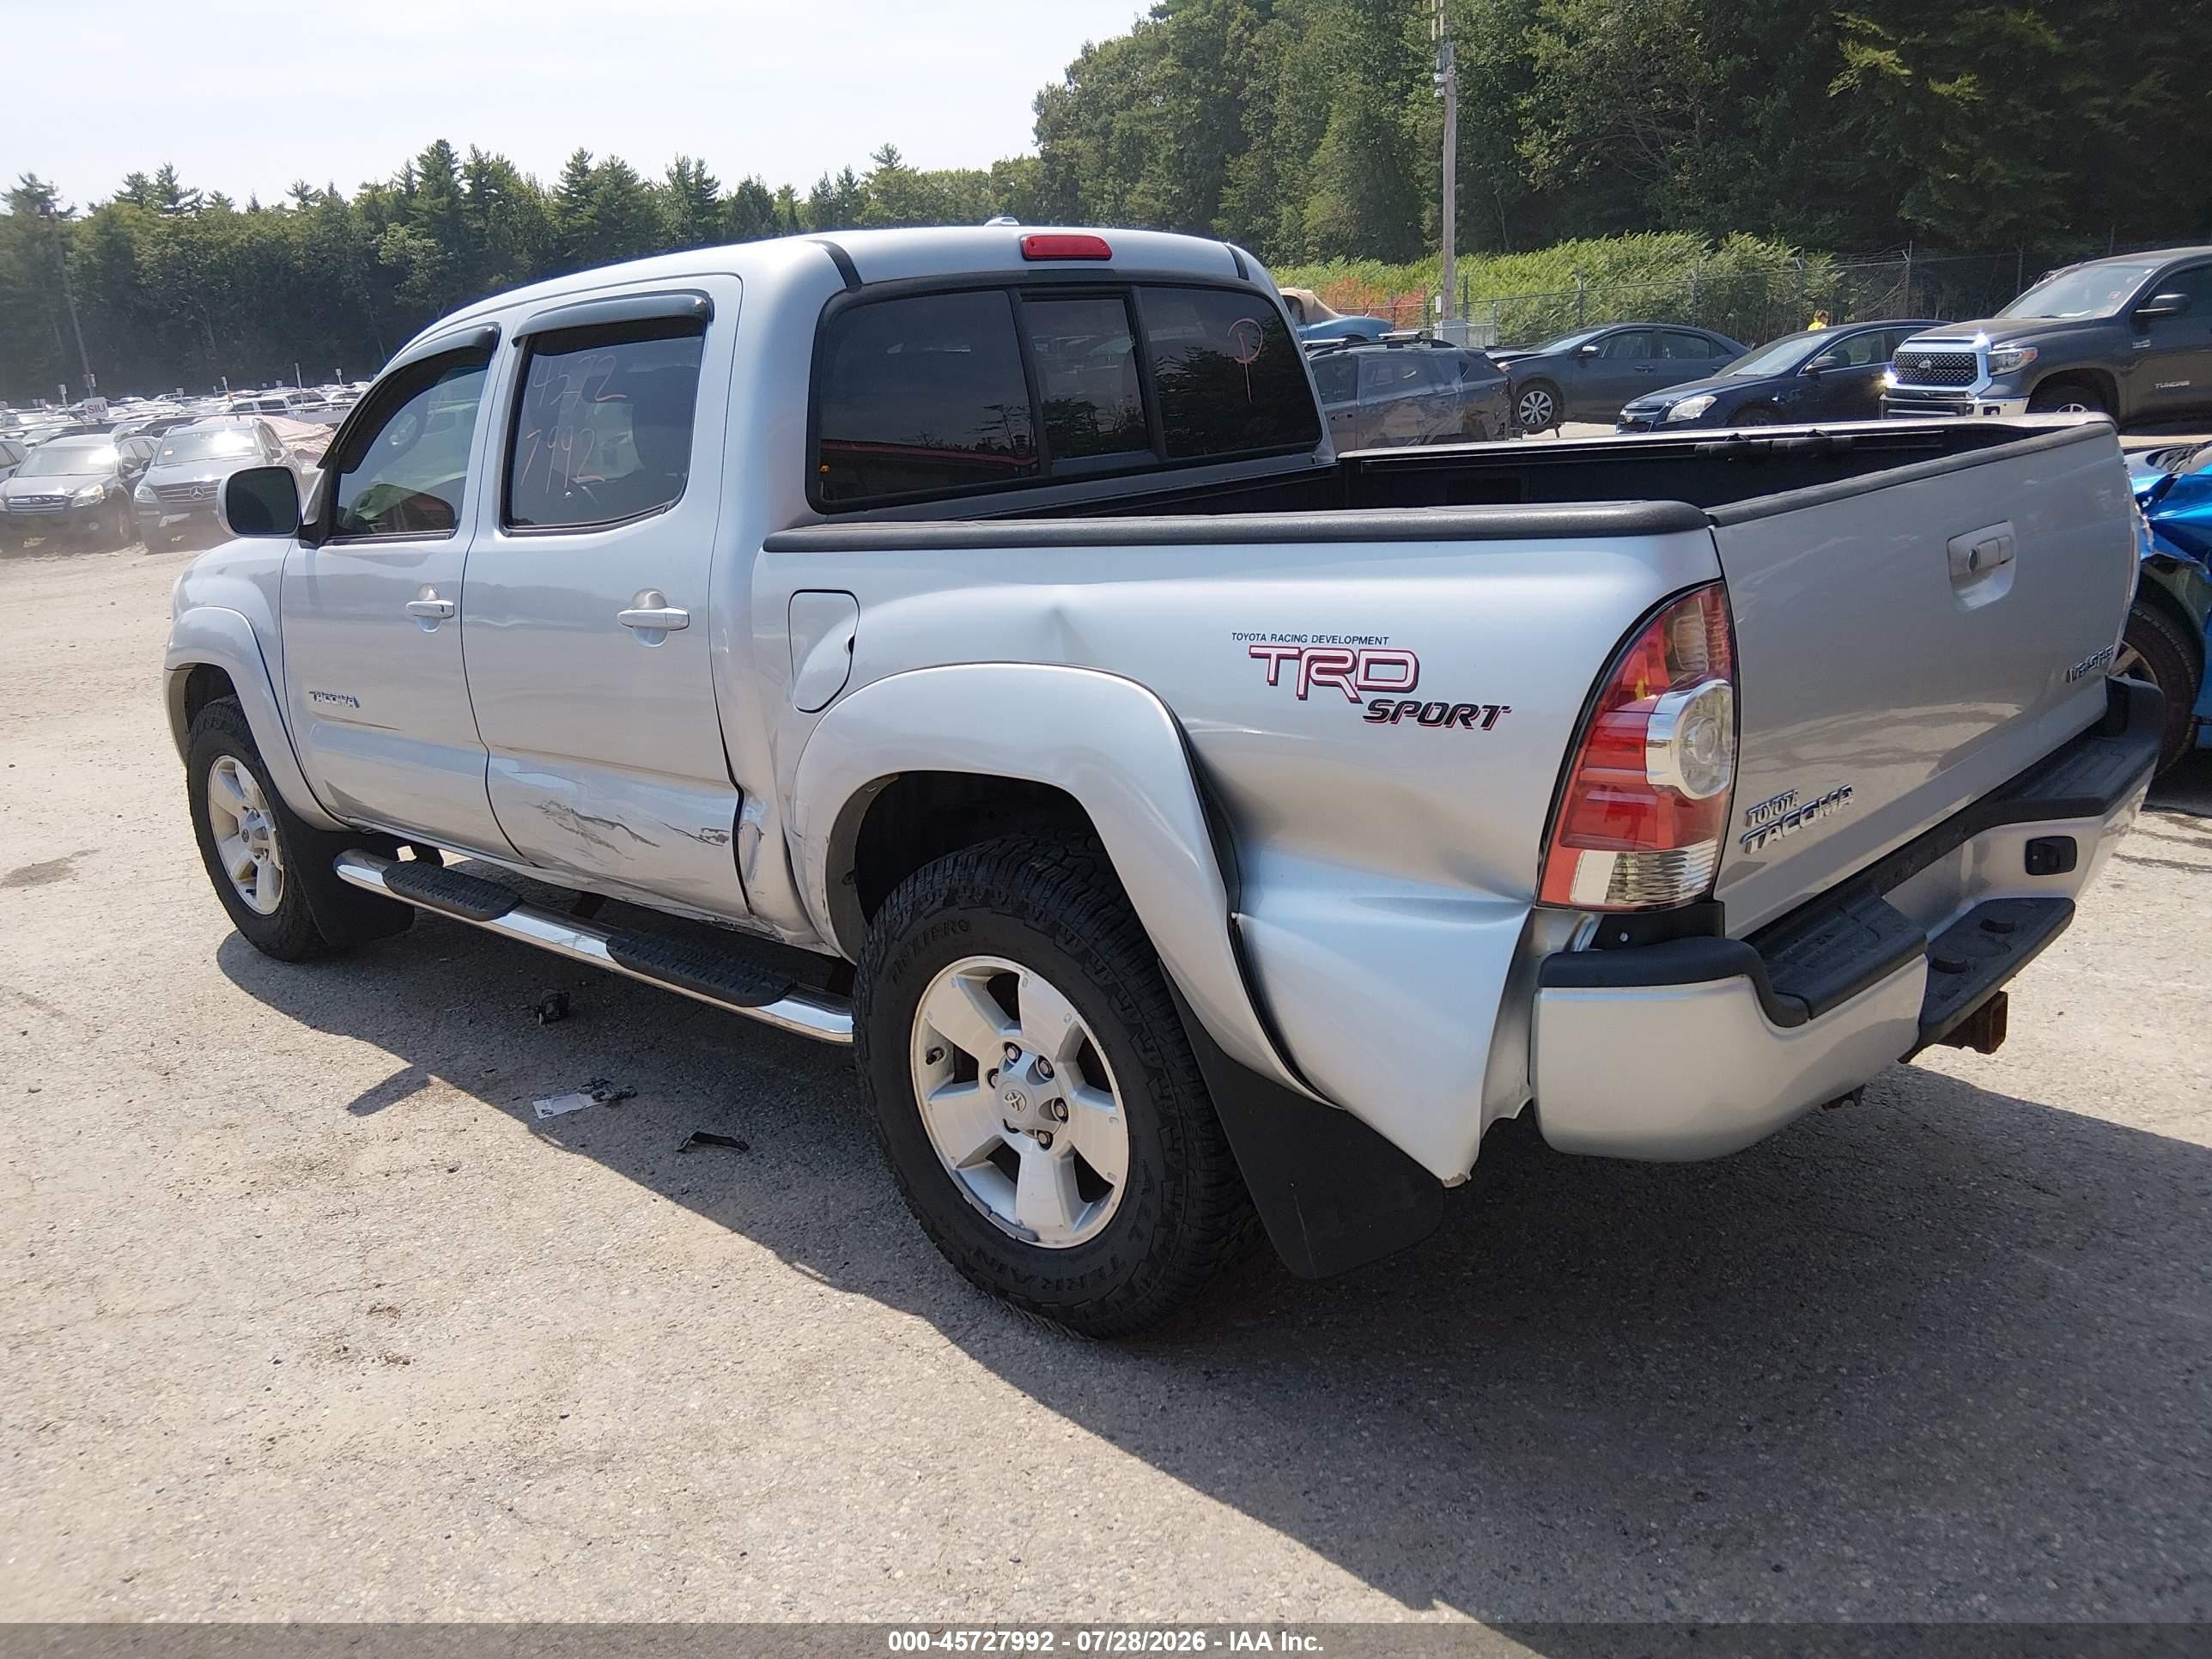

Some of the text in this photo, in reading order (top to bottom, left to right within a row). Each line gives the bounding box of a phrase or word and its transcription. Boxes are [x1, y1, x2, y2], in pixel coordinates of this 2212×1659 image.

[87, 404, 106, 415] SIU
[520, 426, 605, 495] 7992
[1231, 632, 1390, 646] TOYOTA RACING DEVELOPMENT
[1249, 645, 1420, 704] TRD
[308, 690, 361, 708] TACOMA
[1362, 698, 1512, 732] SPORT
[1739, 783, 1855, 854] TACOMA
[1745, 788, 1801, 828] TOYOTA
